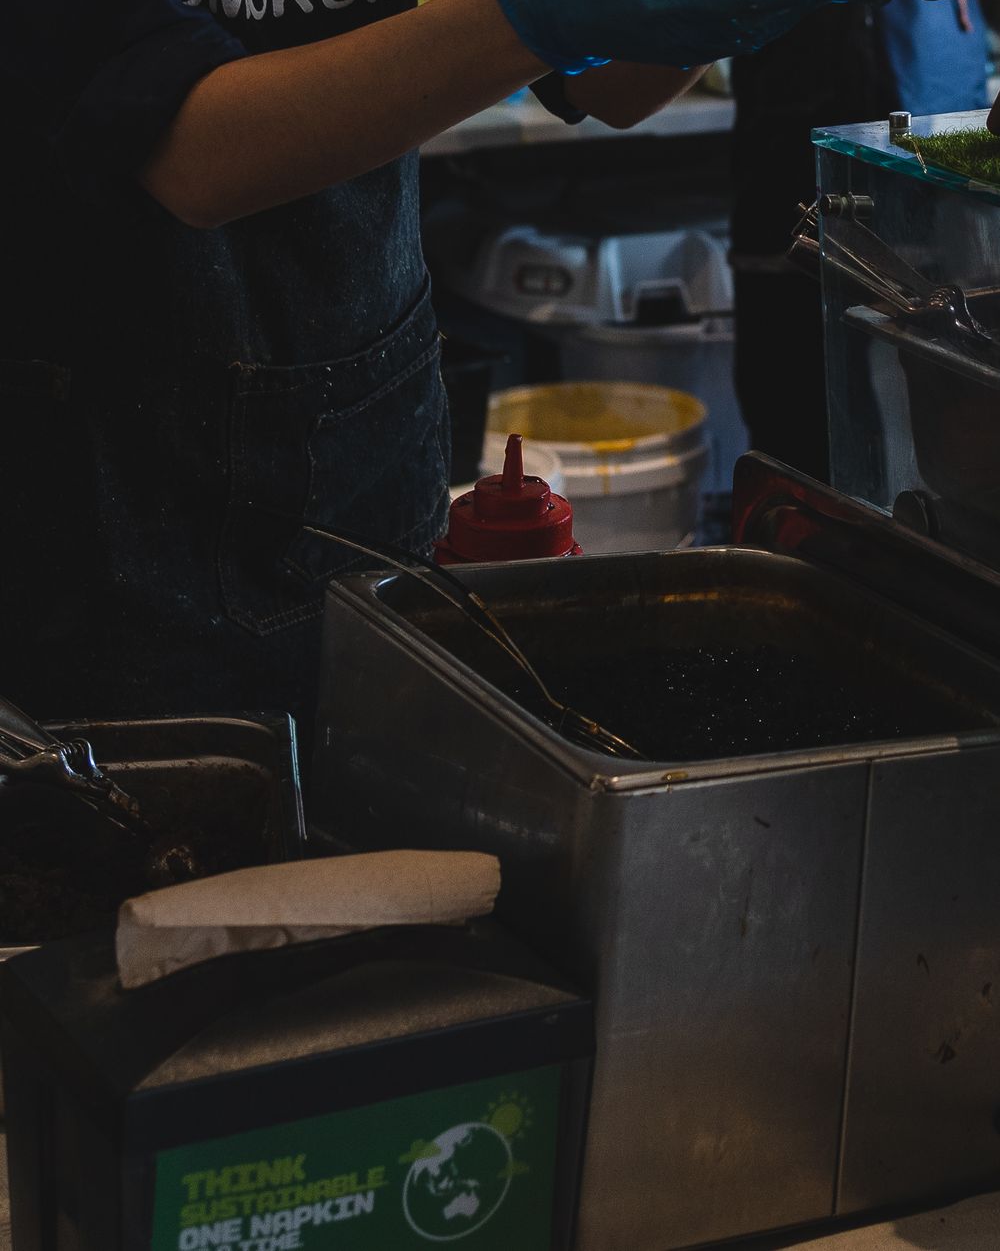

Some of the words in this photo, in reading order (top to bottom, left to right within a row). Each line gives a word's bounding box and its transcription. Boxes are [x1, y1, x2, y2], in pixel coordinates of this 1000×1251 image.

[183, 1154, 306, 1200] THINK
[179, 1218, 242, 1251] ONE
[251, 1191, 374, 1236] NAPKIN
